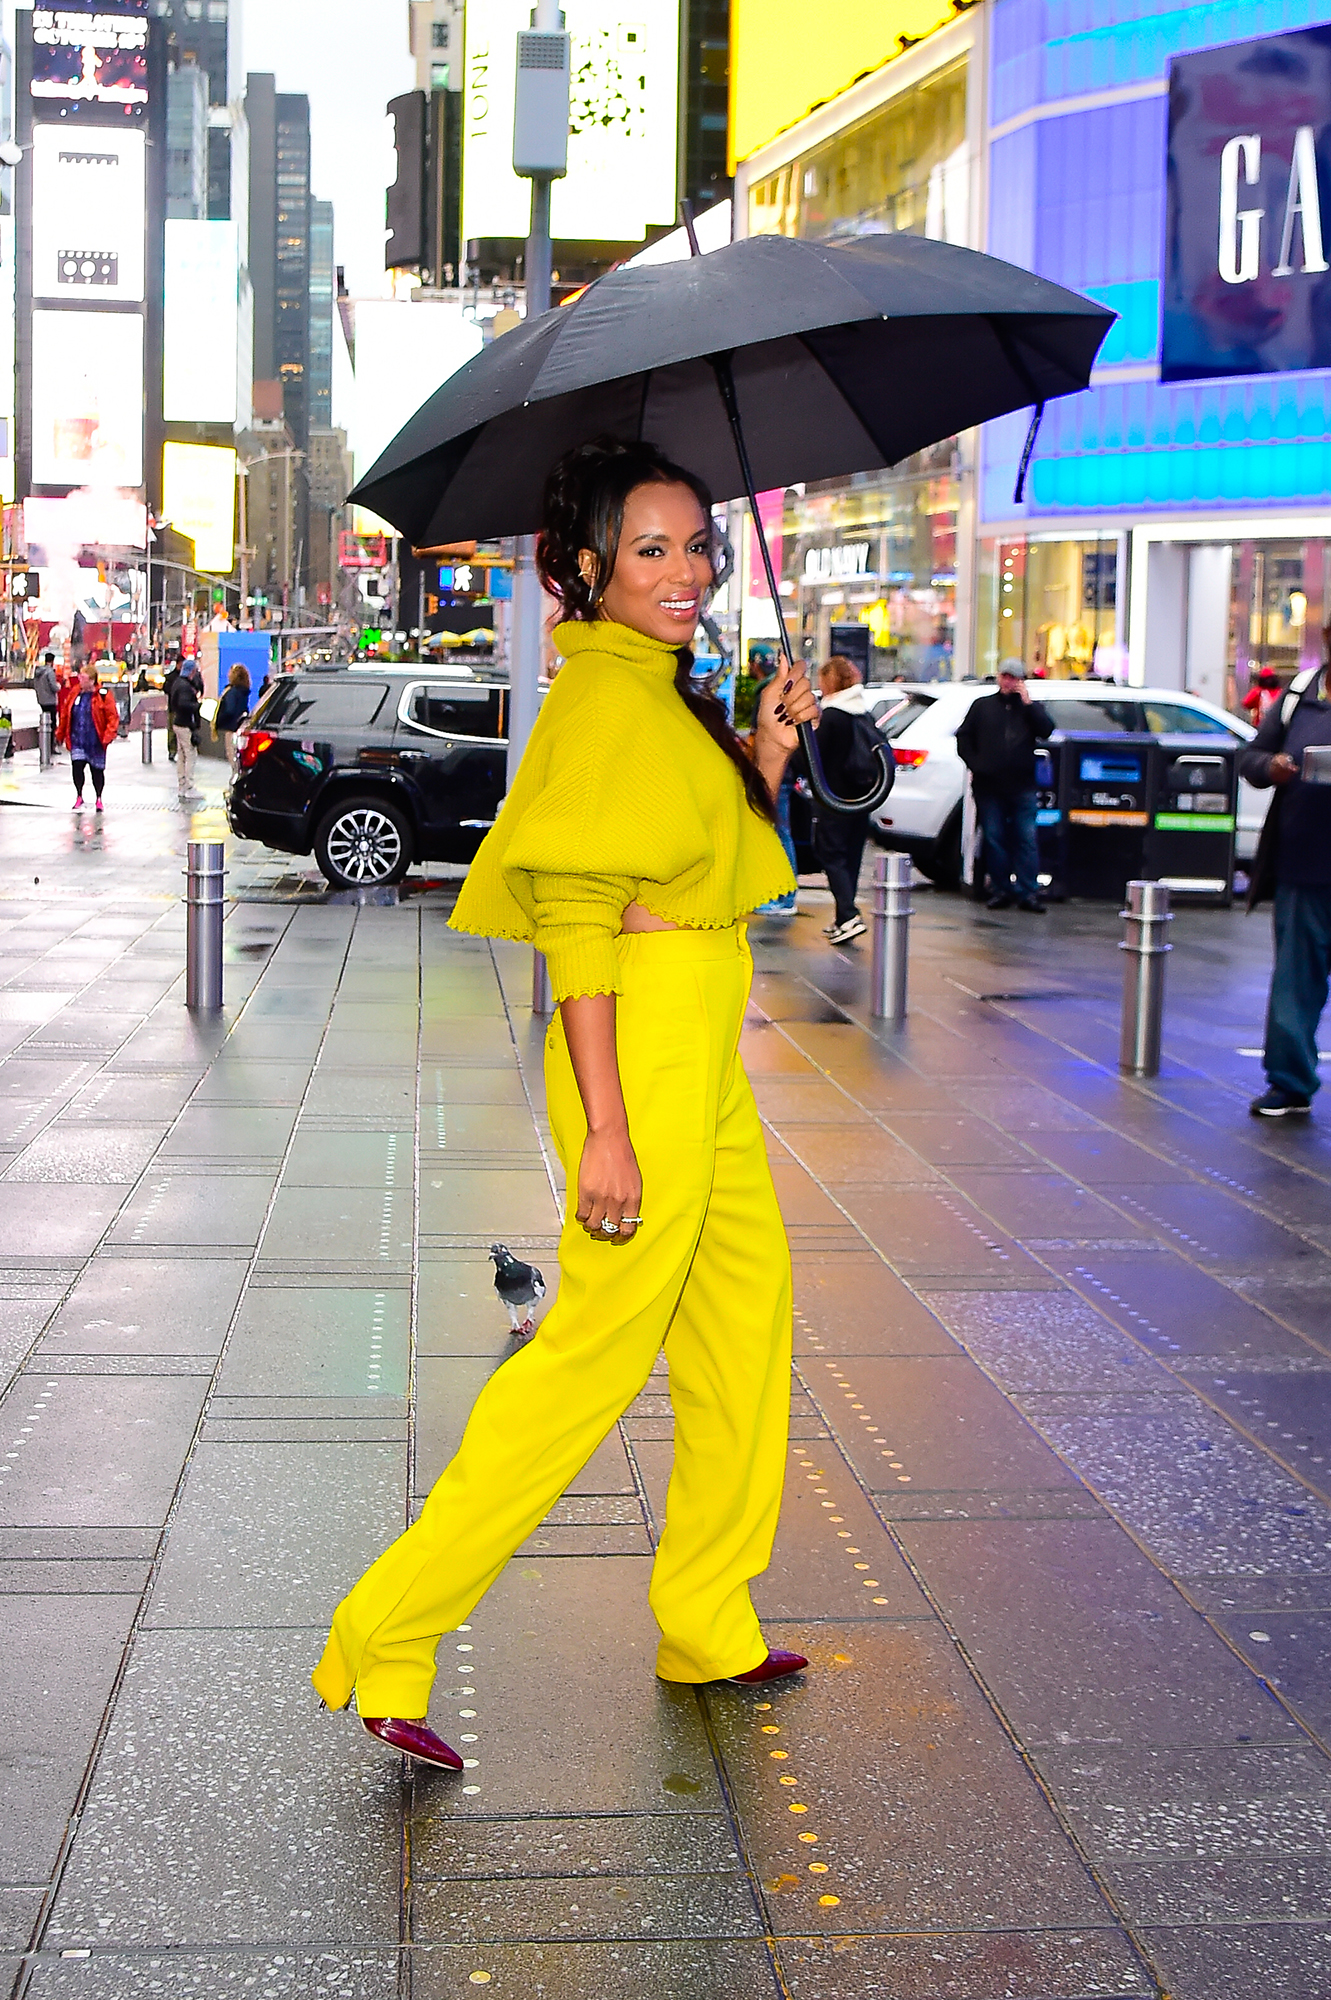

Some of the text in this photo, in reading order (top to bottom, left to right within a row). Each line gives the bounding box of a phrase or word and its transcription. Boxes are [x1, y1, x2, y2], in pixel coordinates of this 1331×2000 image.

[1218, 125, 1330, 283] GA
[805, 542, 869, 578] OLD NAVY
